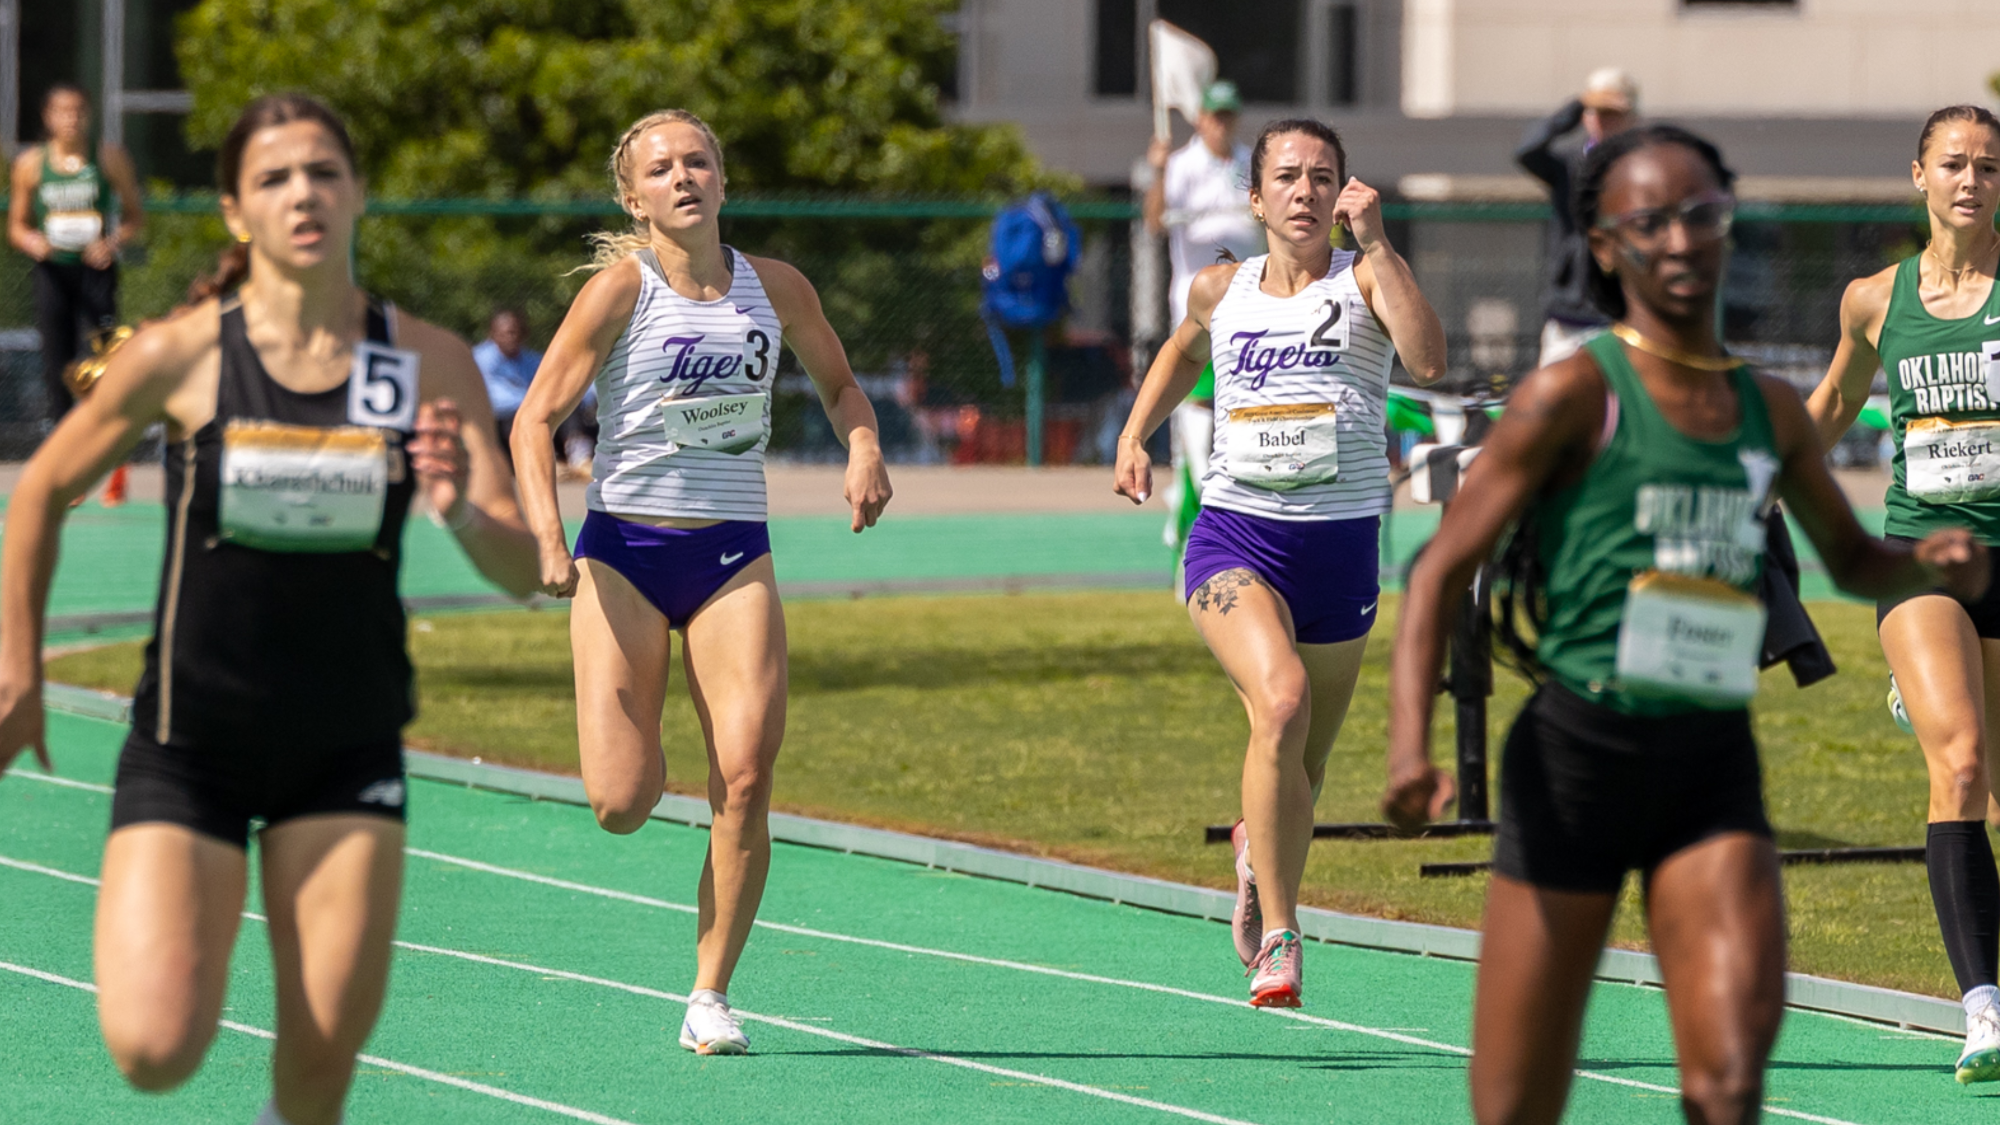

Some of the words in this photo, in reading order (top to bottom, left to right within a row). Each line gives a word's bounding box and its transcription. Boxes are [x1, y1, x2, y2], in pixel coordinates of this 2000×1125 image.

[1311, 299, 1341, 348] 2
[745, 329, 770, 382] 3
[1899, 351, 1985, 391] OKLAHO
[363, 352, 403, 415] 5
[681, 401, 748, 425] Woolsey
[1259, 430, 1306, 447] Babel
